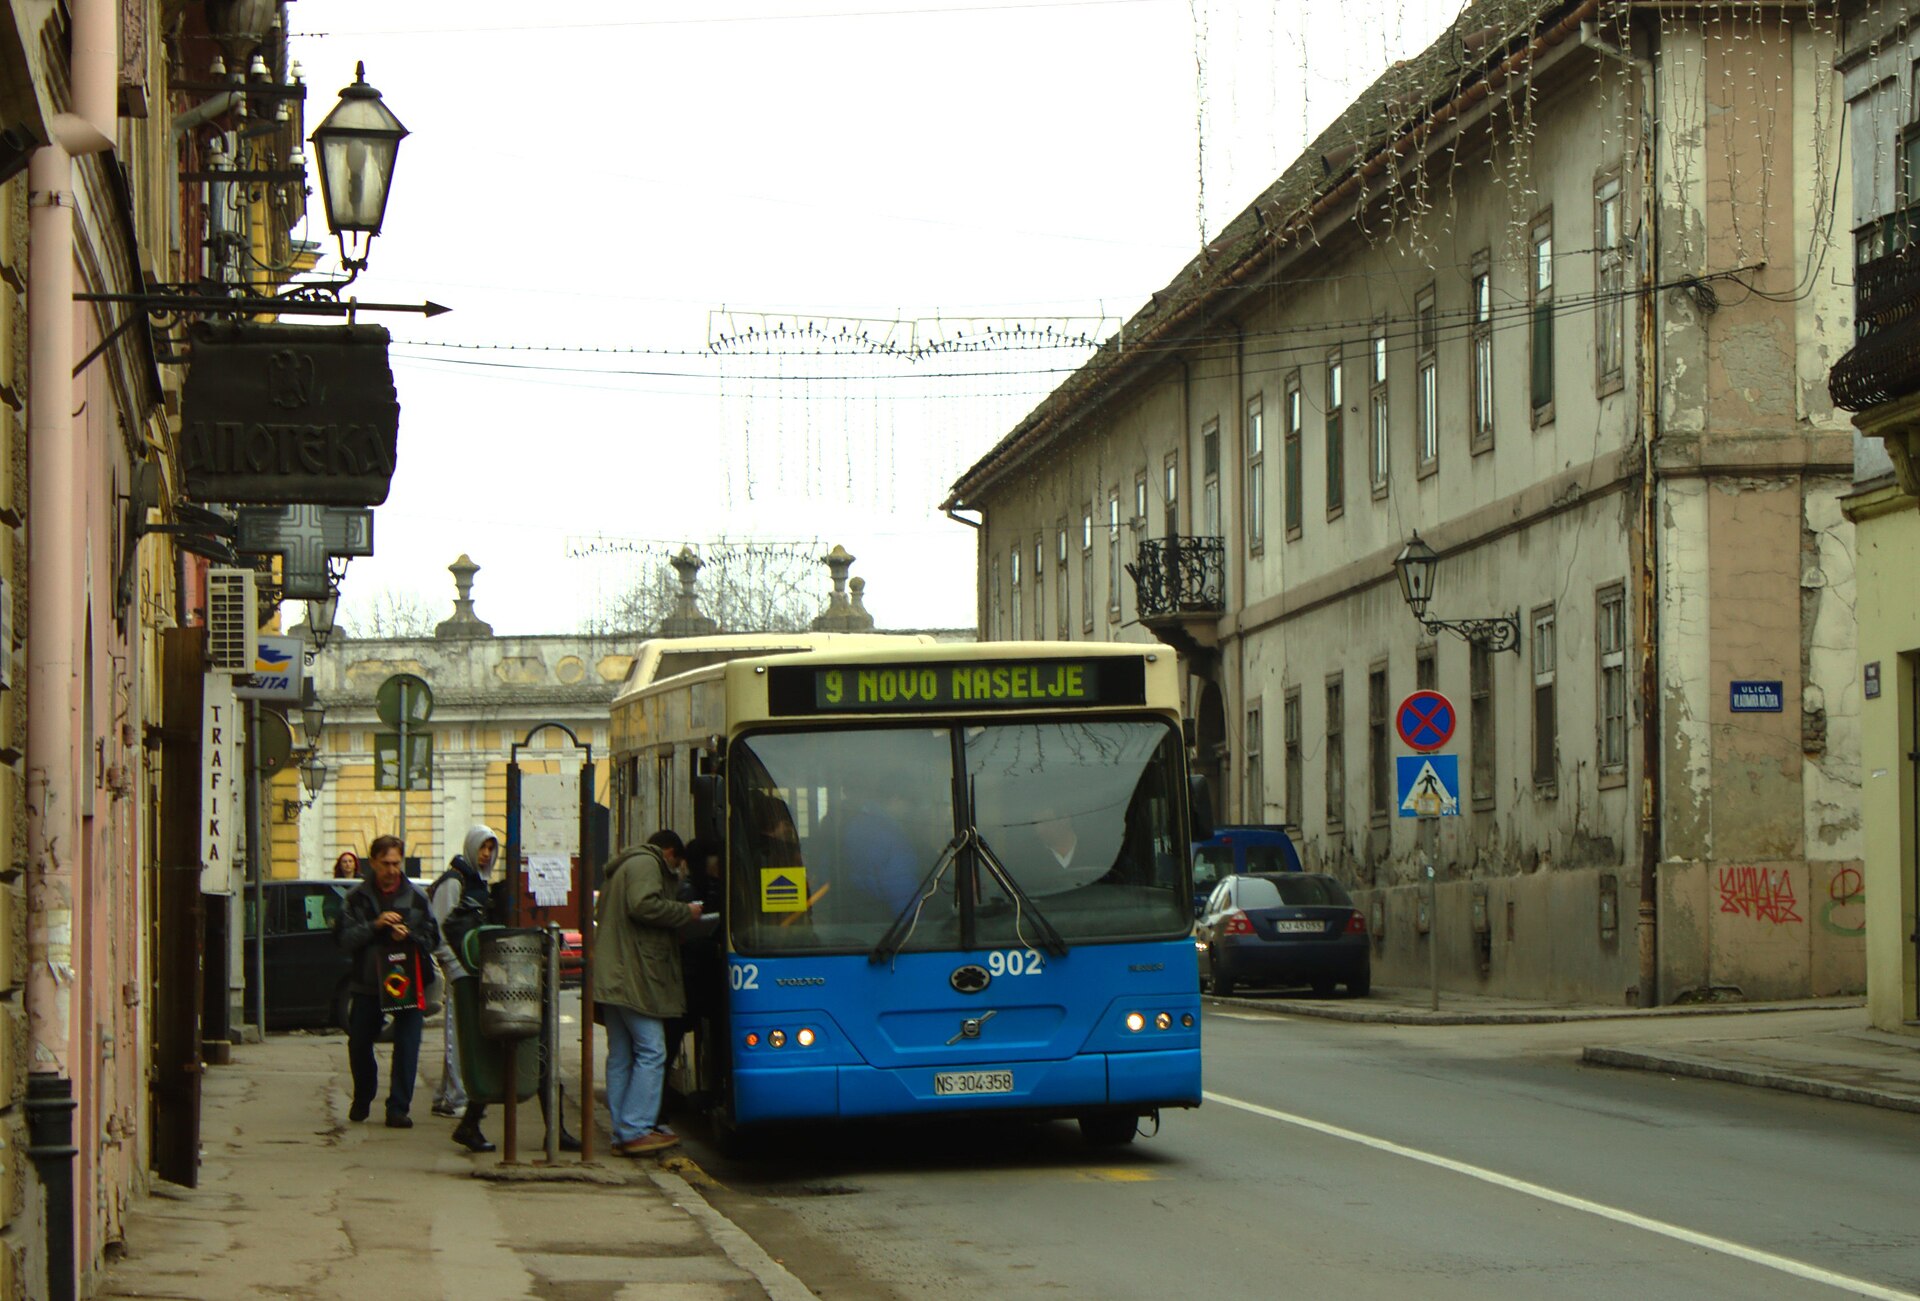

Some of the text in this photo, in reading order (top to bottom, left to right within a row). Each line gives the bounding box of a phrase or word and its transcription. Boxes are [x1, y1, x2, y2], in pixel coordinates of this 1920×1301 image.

[826, 665, 1084, 703] 9 NOVO NASELJE
[1741, 686, 1771, 694] ULICA
[209, 705, 222, 860] TRAFIKA
[728, 963, 759, 990] 02
[988, 949, 1042, 977] 902
[776, 977, 825, 986] VOLVO
